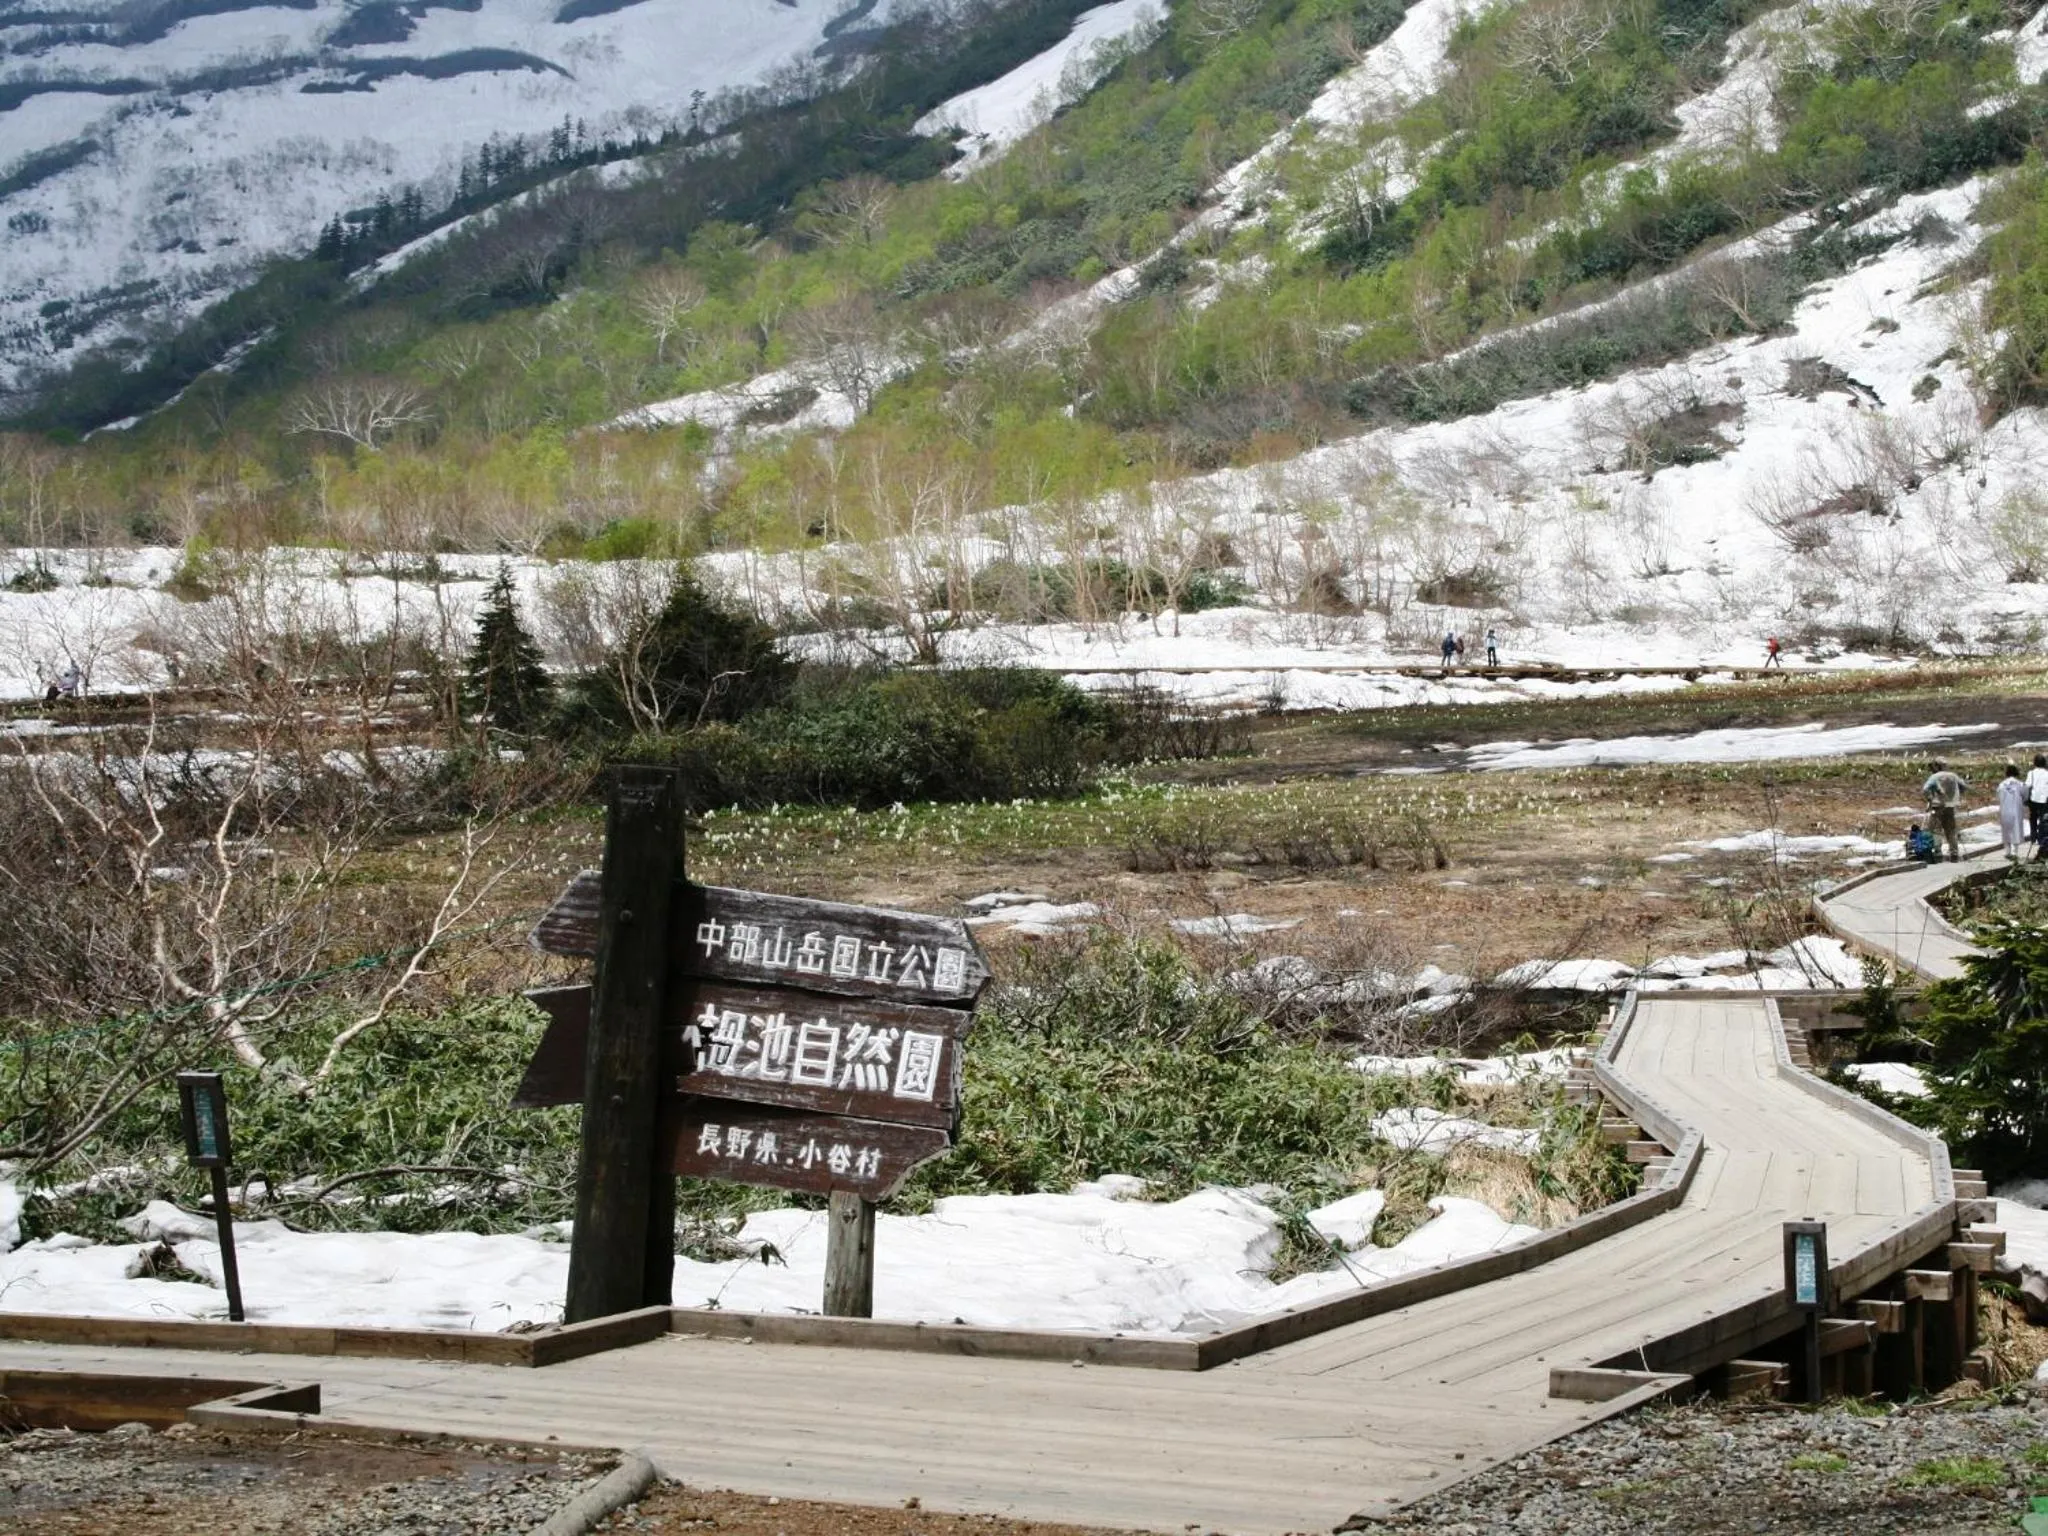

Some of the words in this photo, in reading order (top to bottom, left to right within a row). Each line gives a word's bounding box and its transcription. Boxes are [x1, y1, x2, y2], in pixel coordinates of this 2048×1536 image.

[696, 918, 966, 991] 中部山岳国立公園
[682, 1003, 944, 1102] 栂池自然園
